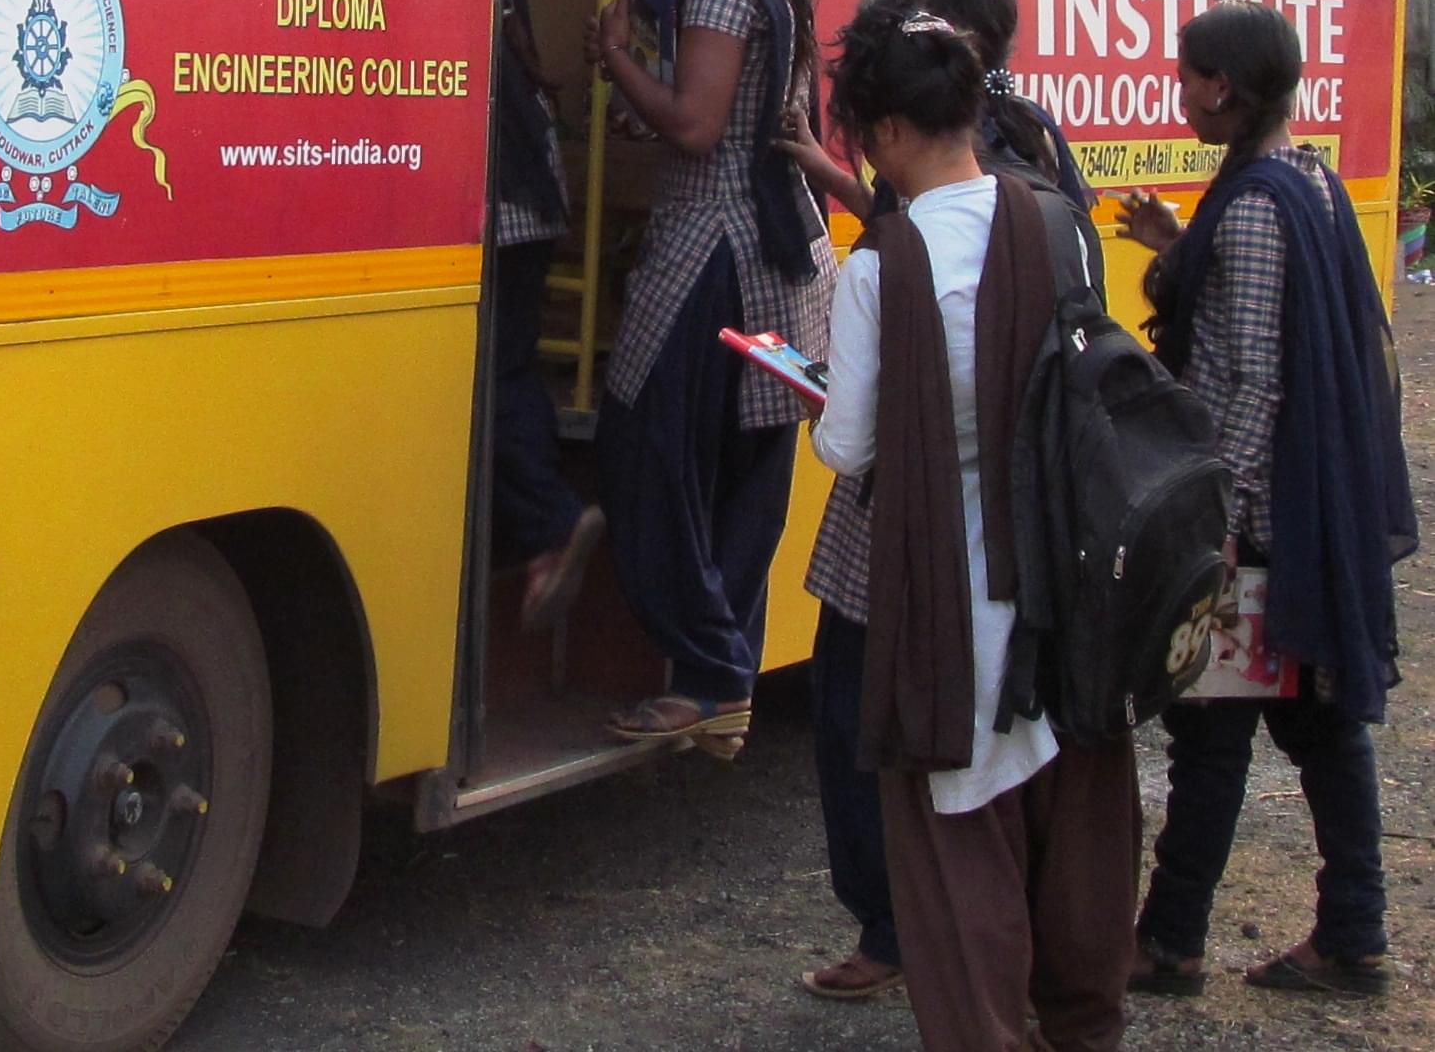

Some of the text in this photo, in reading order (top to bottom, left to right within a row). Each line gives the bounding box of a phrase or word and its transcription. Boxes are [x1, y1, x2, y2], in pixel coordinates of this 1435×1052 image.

[173, 52, 468, 97] ENGINEERING COLLEGE
[48, 119, 94, 164] CUTTACK
[220, 139, 421, 171] www.sits-india.org
[1133, 144, 1172, 175] e-Mail
